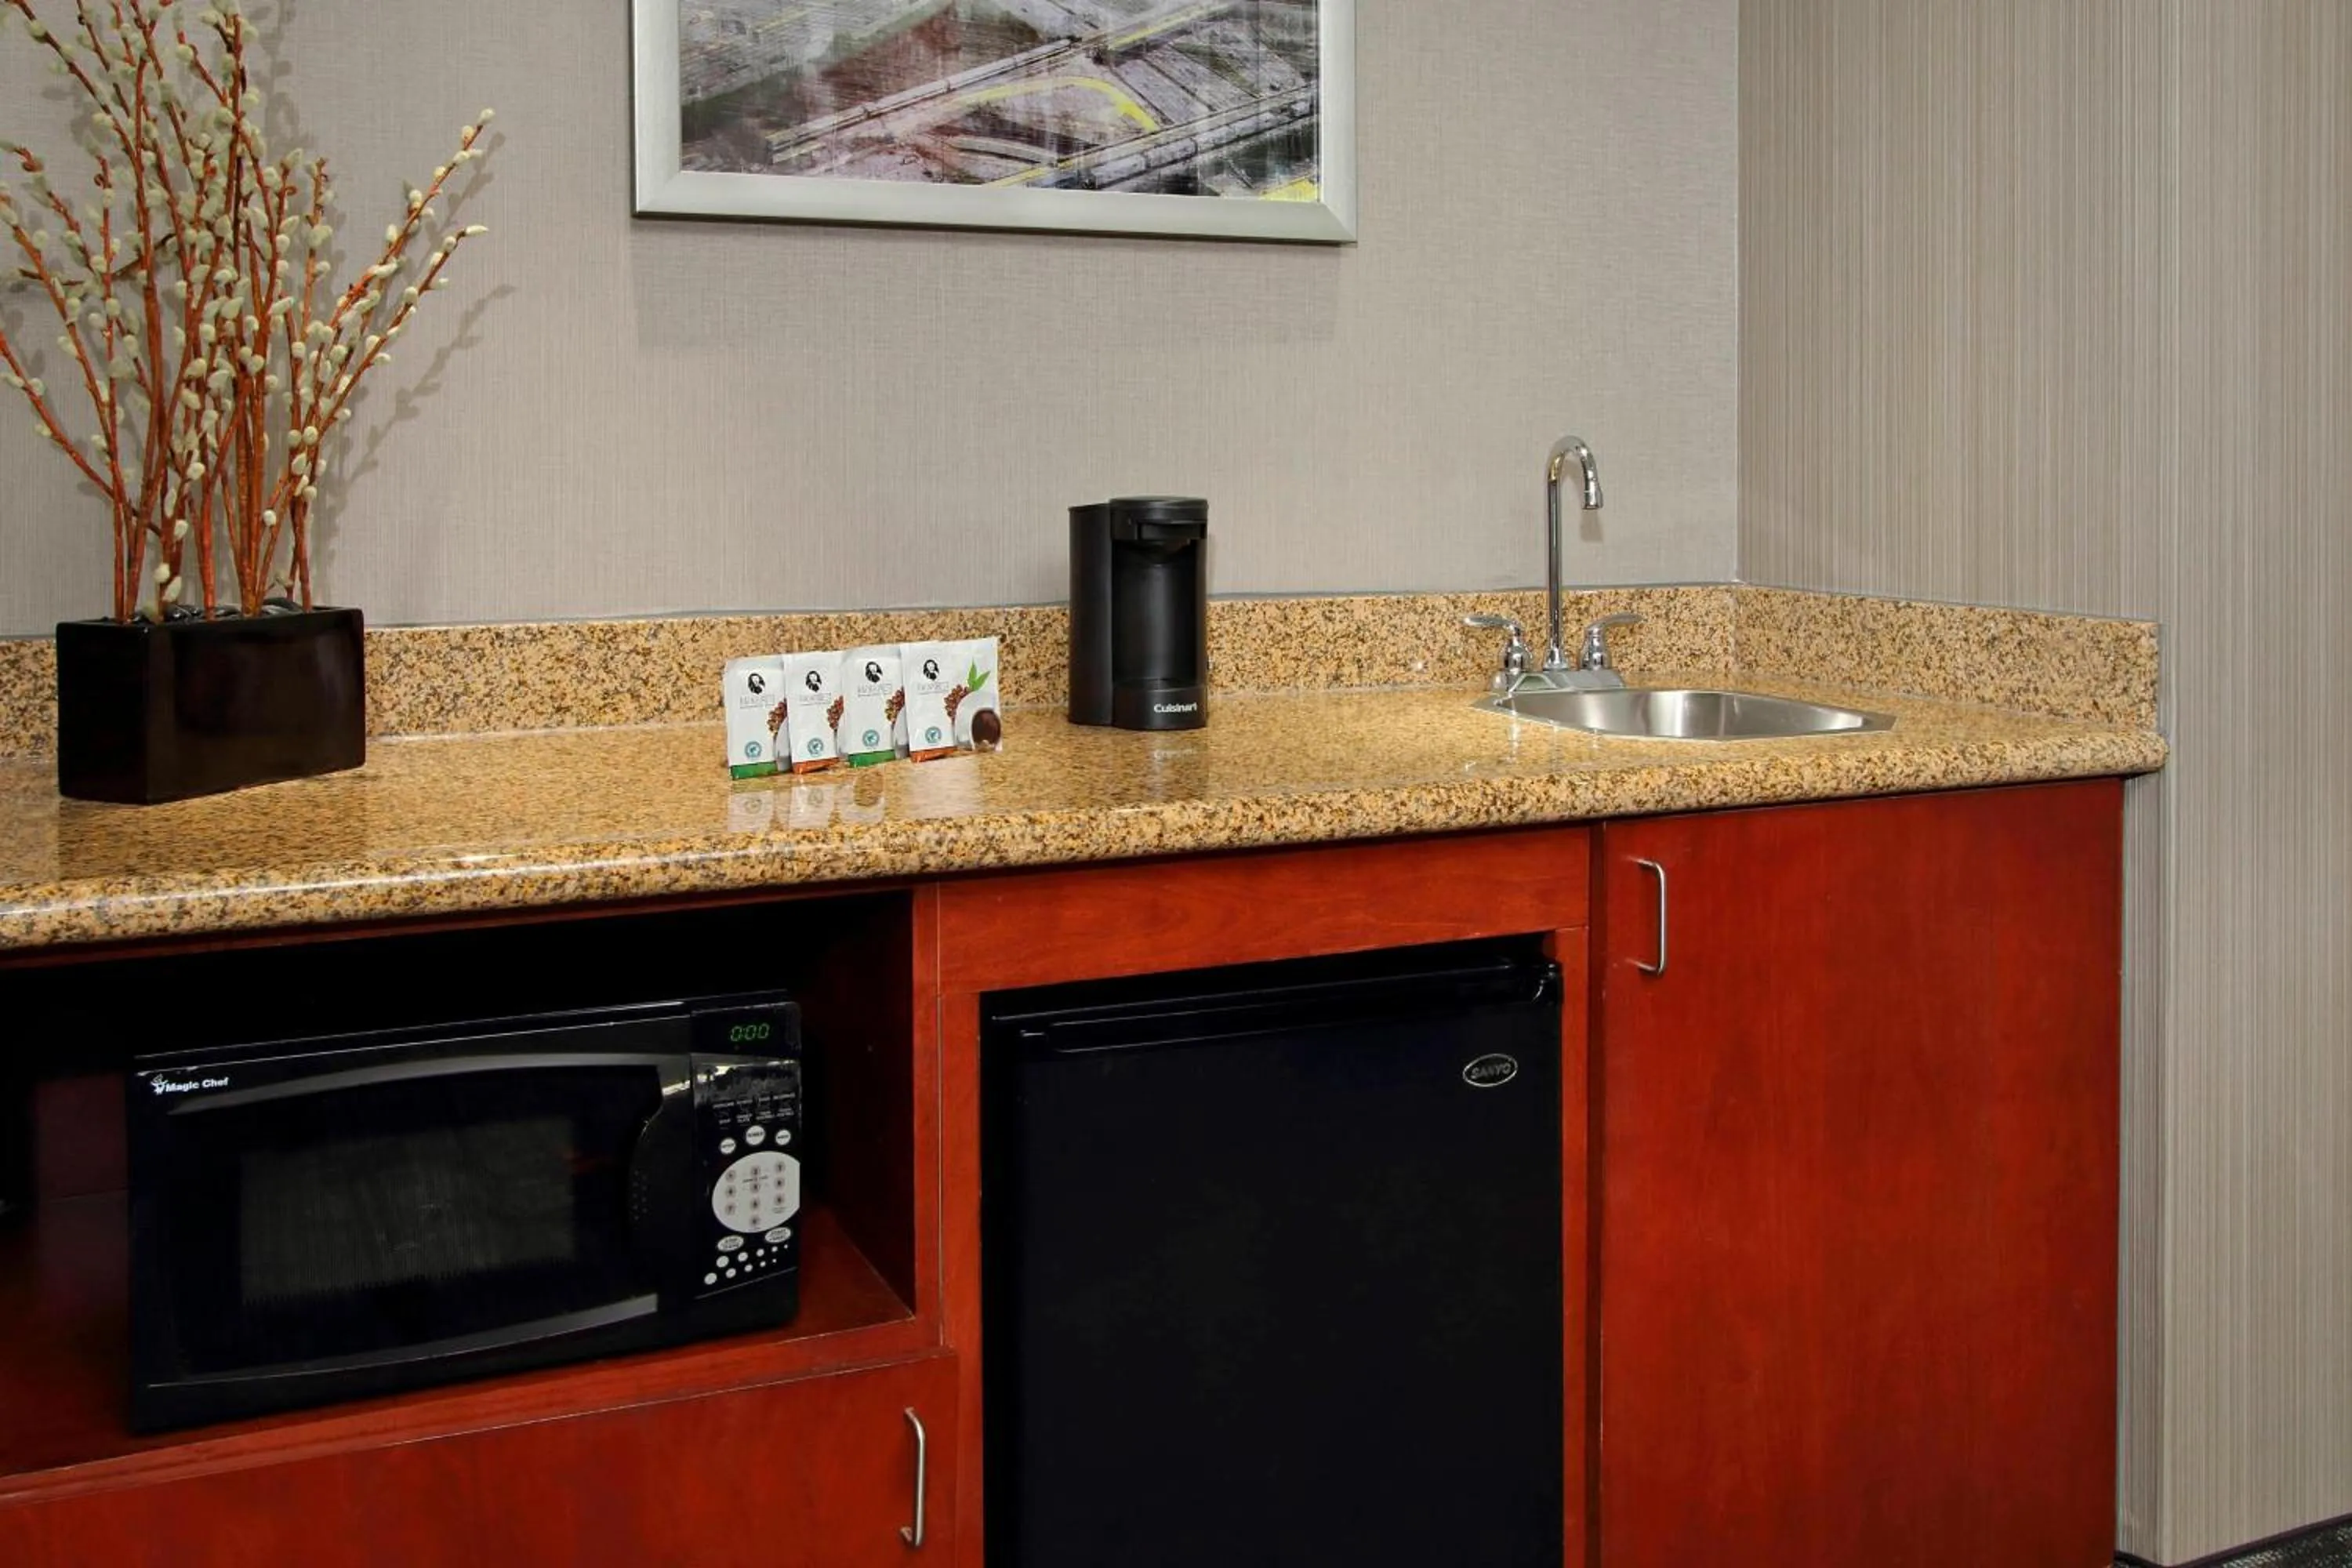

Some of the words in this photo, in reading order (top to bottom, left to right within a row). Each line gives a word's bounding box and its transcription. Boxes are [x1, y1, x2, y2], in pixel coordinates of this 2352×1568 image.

[1153, 702, 1197, 713] Cuisinart
[1471, 1062, 1511, 1080] SANYO
[165, 1080, 199, 1092] Magic
[201, 1076, 229, 1087] Chef
